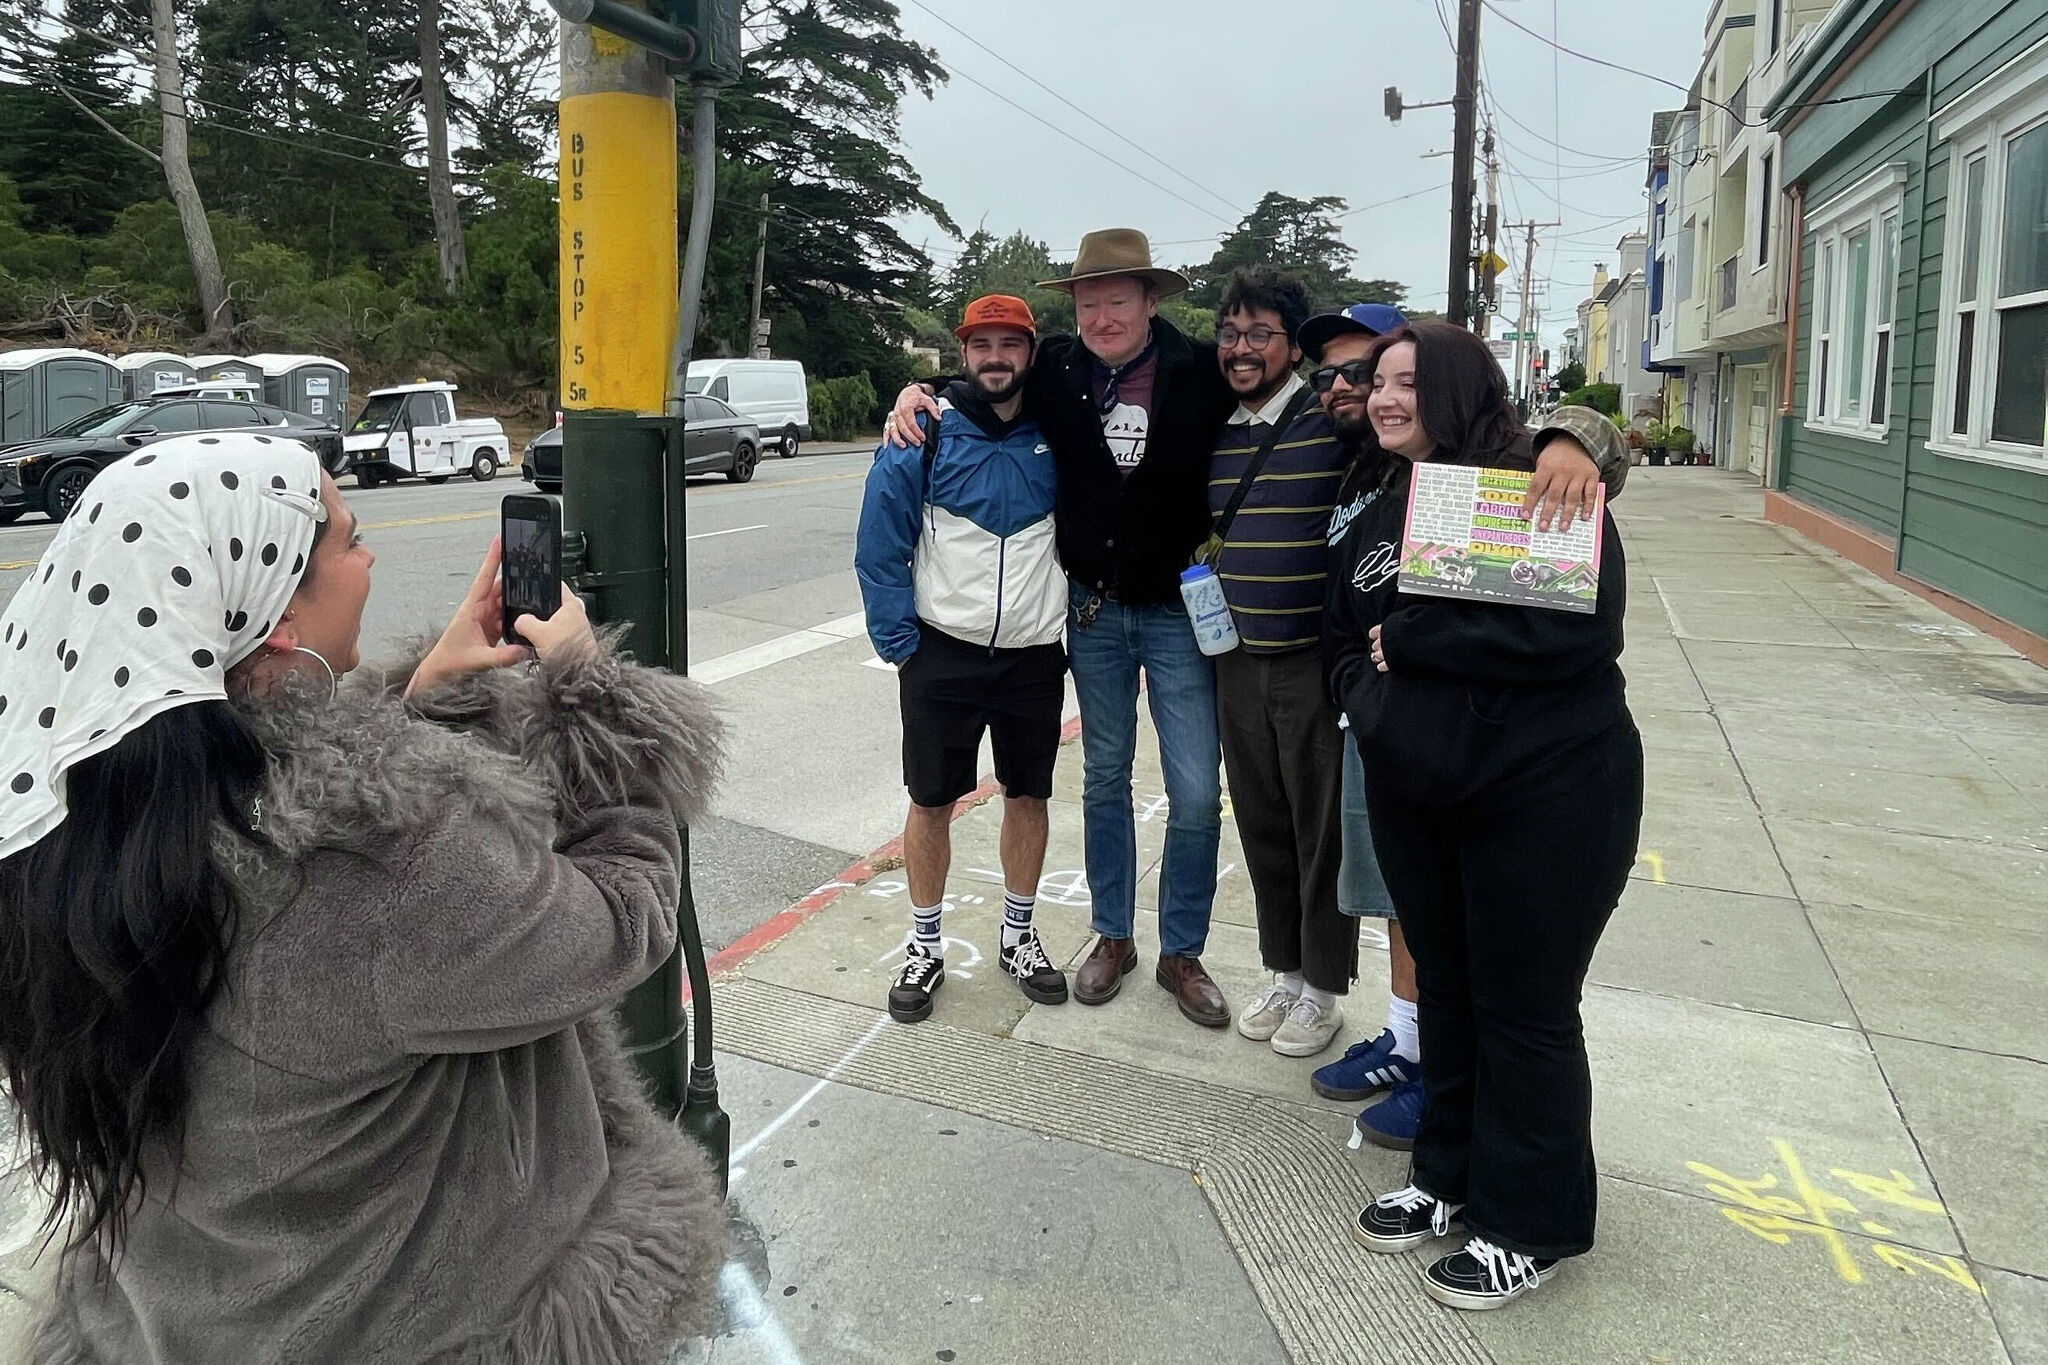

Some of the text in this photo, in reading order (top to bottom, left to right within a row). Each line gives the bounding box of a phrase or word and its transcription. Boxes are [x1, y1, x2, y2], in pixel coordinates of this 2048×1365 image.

[571, 132, 585, 365] BUS STOP 5
[569, 382, 587, 401] 5R
